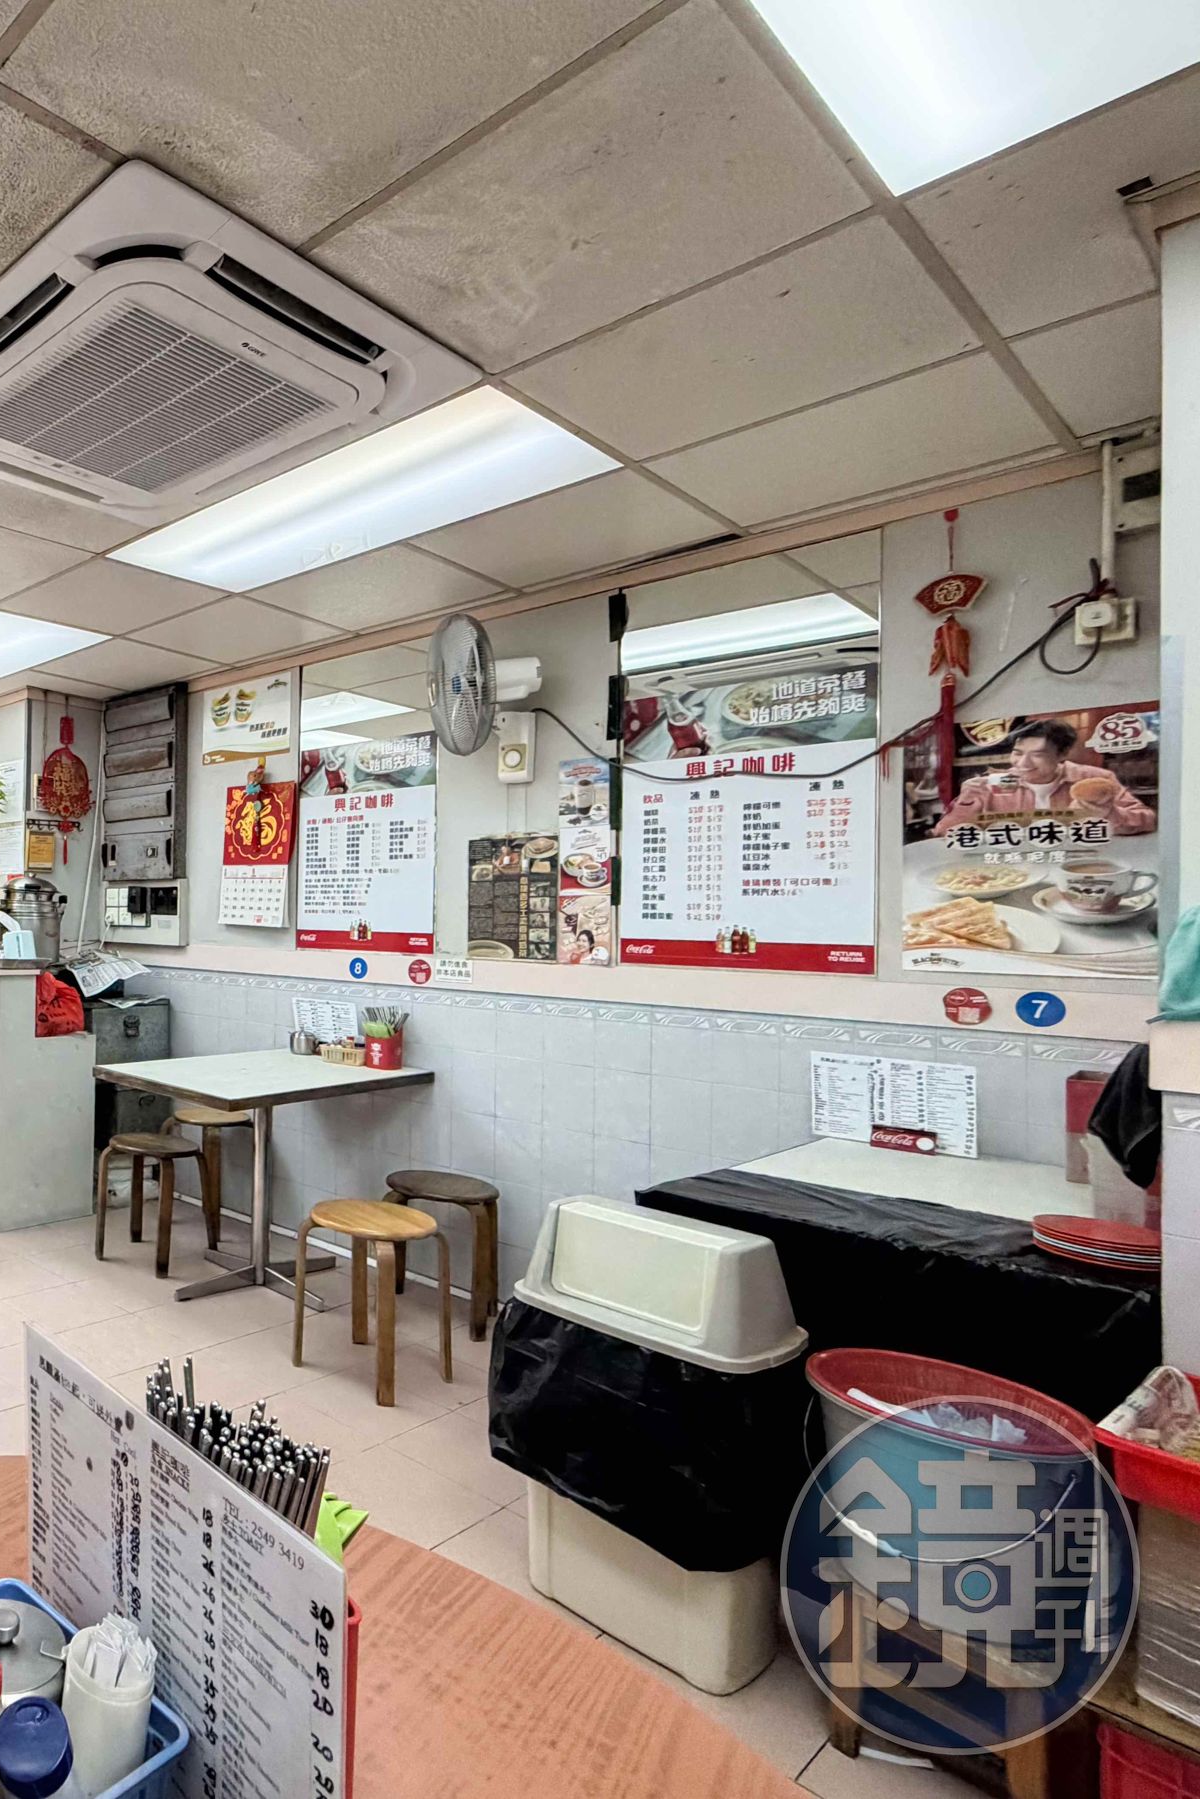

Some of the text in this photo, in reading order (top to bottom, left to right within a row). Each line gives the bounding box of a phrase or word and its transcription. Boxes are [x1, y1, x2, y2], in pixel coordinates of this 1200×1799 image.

[1100, 718, 1141, 741] 85
[686, 752, 795, 780] 興記咖啡
[335, 793, 394, 812] 興記咖啡
[947, 819, 1111, 848] 港式味道
[354, 962, 362, 974] 8
[1031, 999, 1048, 1019] 7
[252, 1522, 275, 1548] 2549
[278, 1543, 304, 1570] 3419
[203, 1581, 214, 1601] 26
[203, 1606, 214, 1624] 26
[310, 1600, 334, 1630] 30
[204, 1631, 214, 1649] 26
[316, 1628, 328, 1657] 18
[317, 1662, 330, 1689] 18
[312, 1689, 334, 1716] 20
[311, 1732, 333, 1763] 20
[314, 1765, 334, 1794] 20
